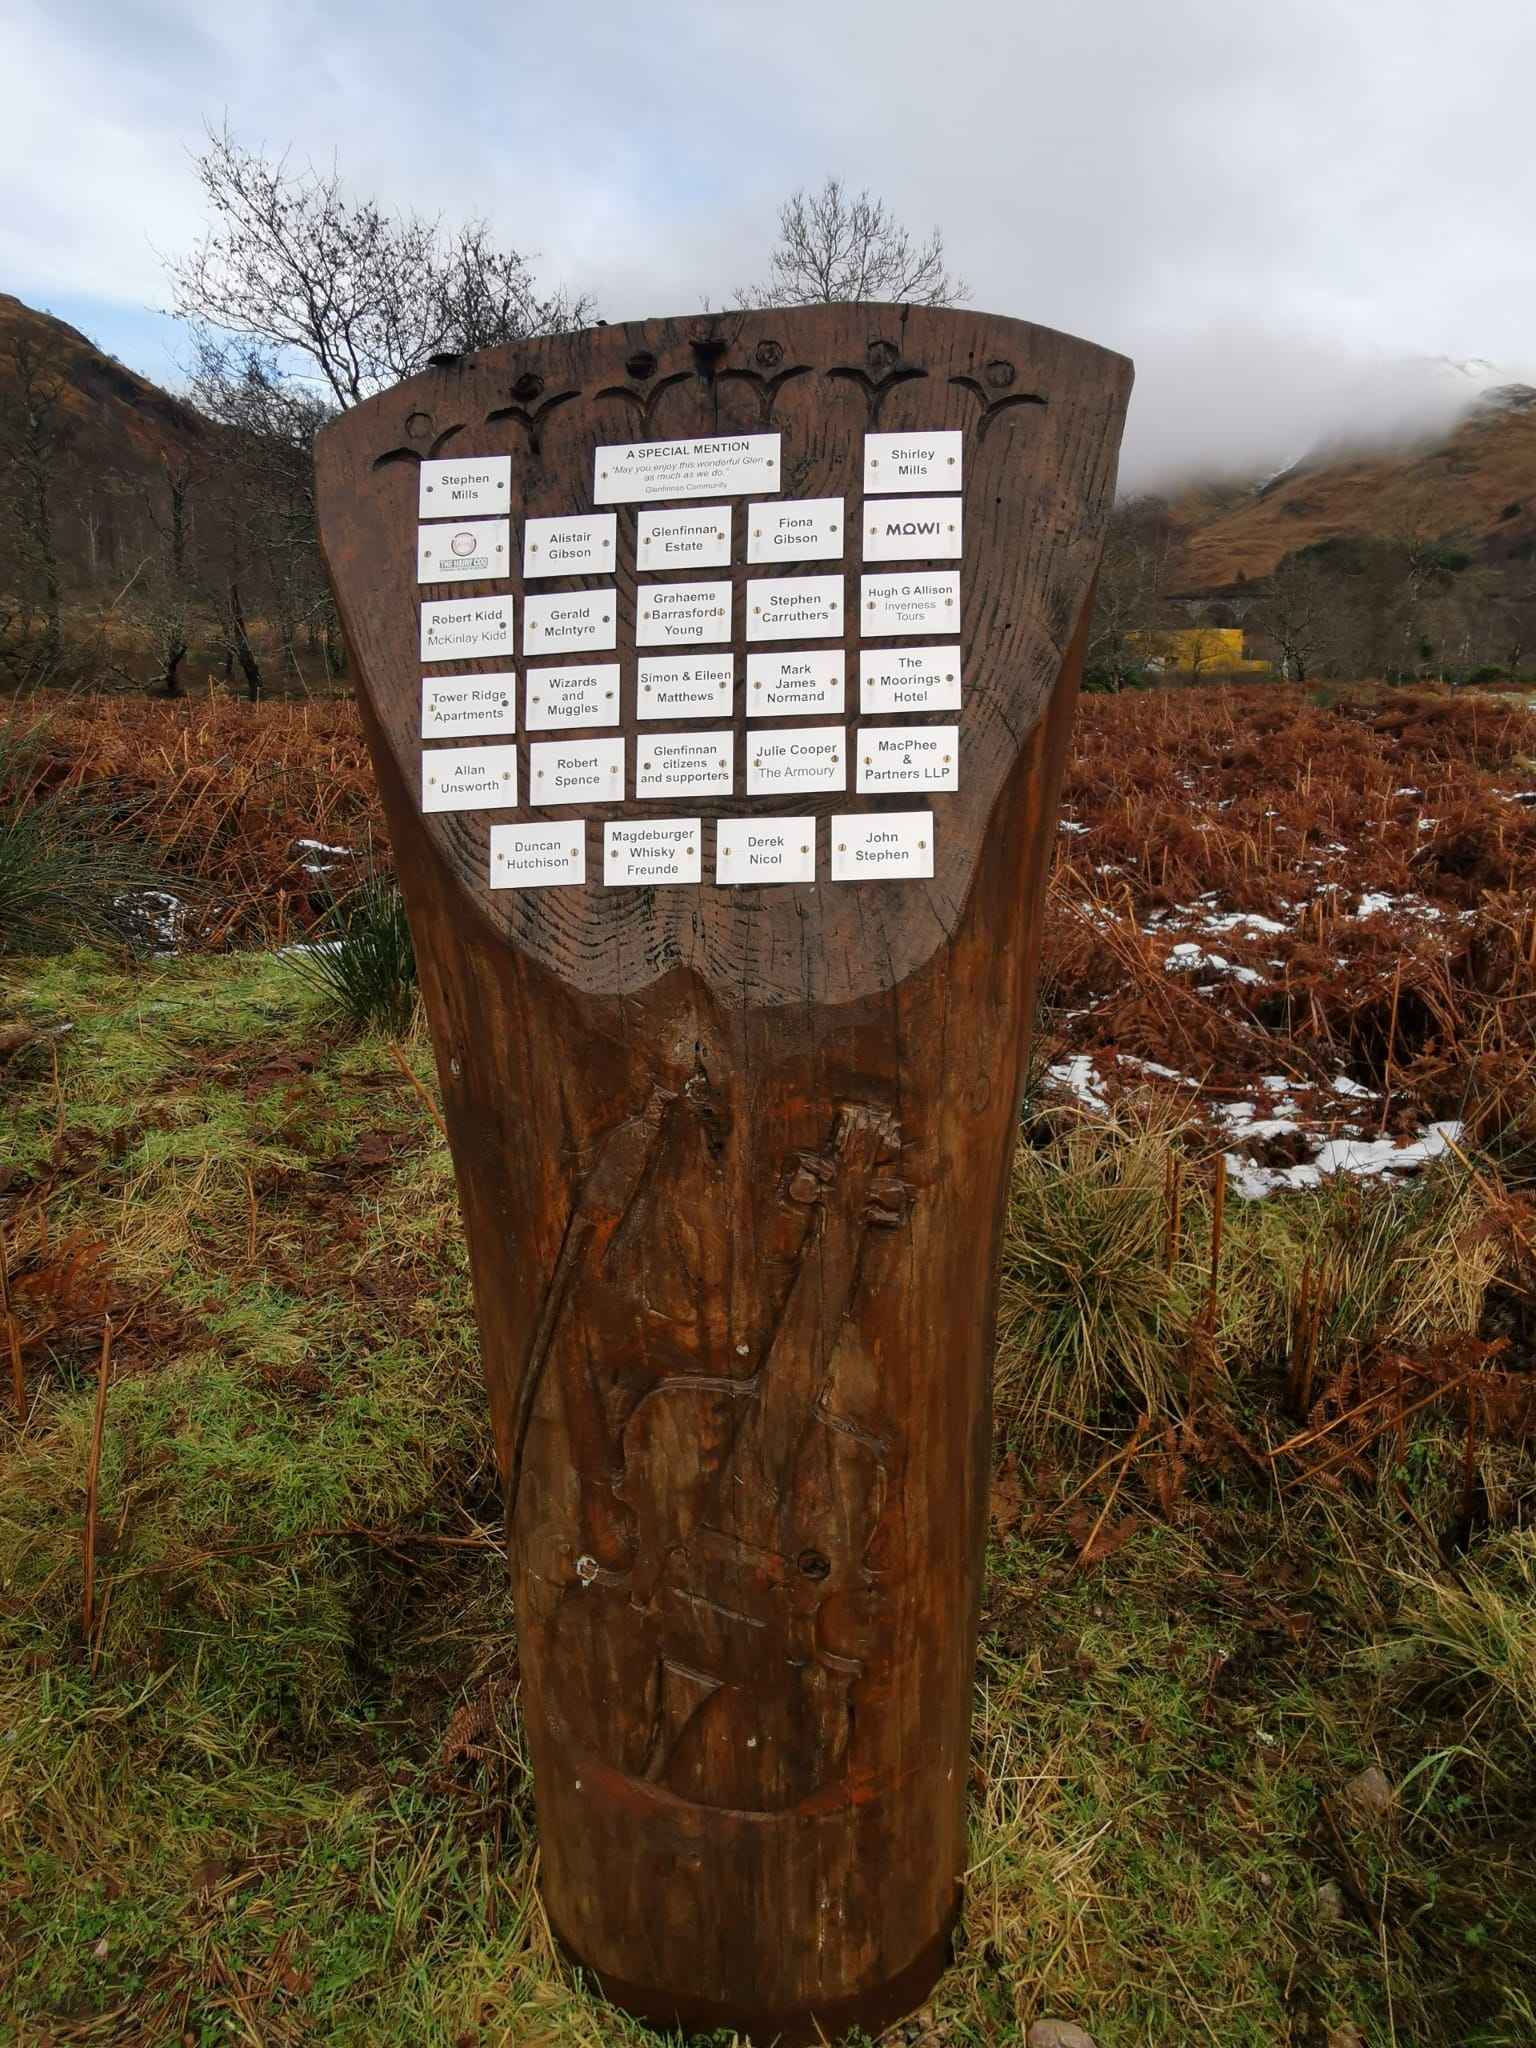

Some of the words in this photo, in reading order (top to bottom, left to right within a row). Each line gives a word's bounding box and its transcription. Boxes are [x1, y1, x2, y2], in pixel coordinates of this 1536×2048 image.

[626, 450, 635, 459] A
[638, 446, 690, 458] SPECIAL
[694, 441, 750, 454] MENTION
[891, 449, 935, 461] Shirley
[636, 465, 651, 473] you
[654, 463, 677, 473] enjoy
[680, 461, 694, 469] this
[698, 458, 740, 468] wonderful
[743, 456, 763, 464] Glen
[899, 465, 928, 475] Mills
[441, 474, 489, 486] Stephen
[657, 472, 681, 480] much
[645, 485, 685, 493] Glenfinnan
[686, 482, 727, 491] Community
[452, 490, 478, 500] Mills
[779, 518, 813, 528] Fiona
[652, 525, 717, 537] Glenfinnan
[550, 532, 592, 544] Alistair
[774, 535, 818, 545] Gibson
[665, 542, 703, 553] Estate
[549, 549, 591, 560] Gibson
[440, 560, 454, 568] THE
[868, 587, 898, 599] Hugh
[901, 587, 911, 596] G
[914, 586, 953, 595] Allison
[654, 593, 716, 604] Grahaeme
[770, 595, 821, 608] Stephen
[885, 601, 936, 611] Inverness
[432, 614, 471, 625] Robert
[475, 610, 503, 621] Kidd
[551, 608, 590, 621] Gerald
[652, 608, 717, 620] Barrasford
[762, 611, 829, 623] Carruthers
[896, 612, 925, 621] Tours
[545, 625, 596, 637] McIntyre
[664, 625, 703, 636] Young
[428, 633, 478, 646] McKinlay
[482, 631, 507, 641] Kidd
[899, 658, 922, 668] The
[781, 664, 811, 675] Mark
[640, 673, 678, 683] Simon
[682, 671, 691, 681] &
[695, 670, 731, 681] Eileen
[880, 674, 941, 686] Moorings
[549, 677, 597, 688] Wizards
[776, 679, 816, 689] James
[432, 692, 468, 703] Tower
[472, 690, 506, 702] Ridge
[562, 691, 584, 701] and
[657, 692, 713, 703] Matthews
[767, 691, 824, 703] Normand
[894, 692, 928, 702] Hotel
[548, 704, 598, 716] Muggles
[434, 710, 504, 723] Apartments
[654, 745, 717, 756] Glenfinnan
[757, 746, 786, 757] Julie
[790, 744, 837, 756] Cooper
[878, 740, 937, 751] MacPhee
[558, 758, 598, 769] Robert
[663, 759, 707, 769] citizens
[903, 755, 912, 764] &
[454, 765, 485, 776] Allan
[760, 768, 781, 778] The
[784, 766, 835, 777] Armoury
[865, 769, 920, 780] Partners
[925, 768, 950, 778] LLP
[555, 774, 600, 788] Spence
[641, 773, 662, 783] and
[665, 771, 729, 784] supporters
[441, 781, 499, 794] Unsworth
[612, 829, 694, 843] Magdeburger
[748, 836, 784, 847] Derek
[866, 832, 898, 843] John
[515, 841, 561, 852] Duncan
[630, 846, 676, 858] Whisky
[750, 854, 782, 864] Nicol
[856, 849, 909, 862] Stephen
[507, 857, 569, 870] Hutchison
[628, 864, 679, 875] Freunde
